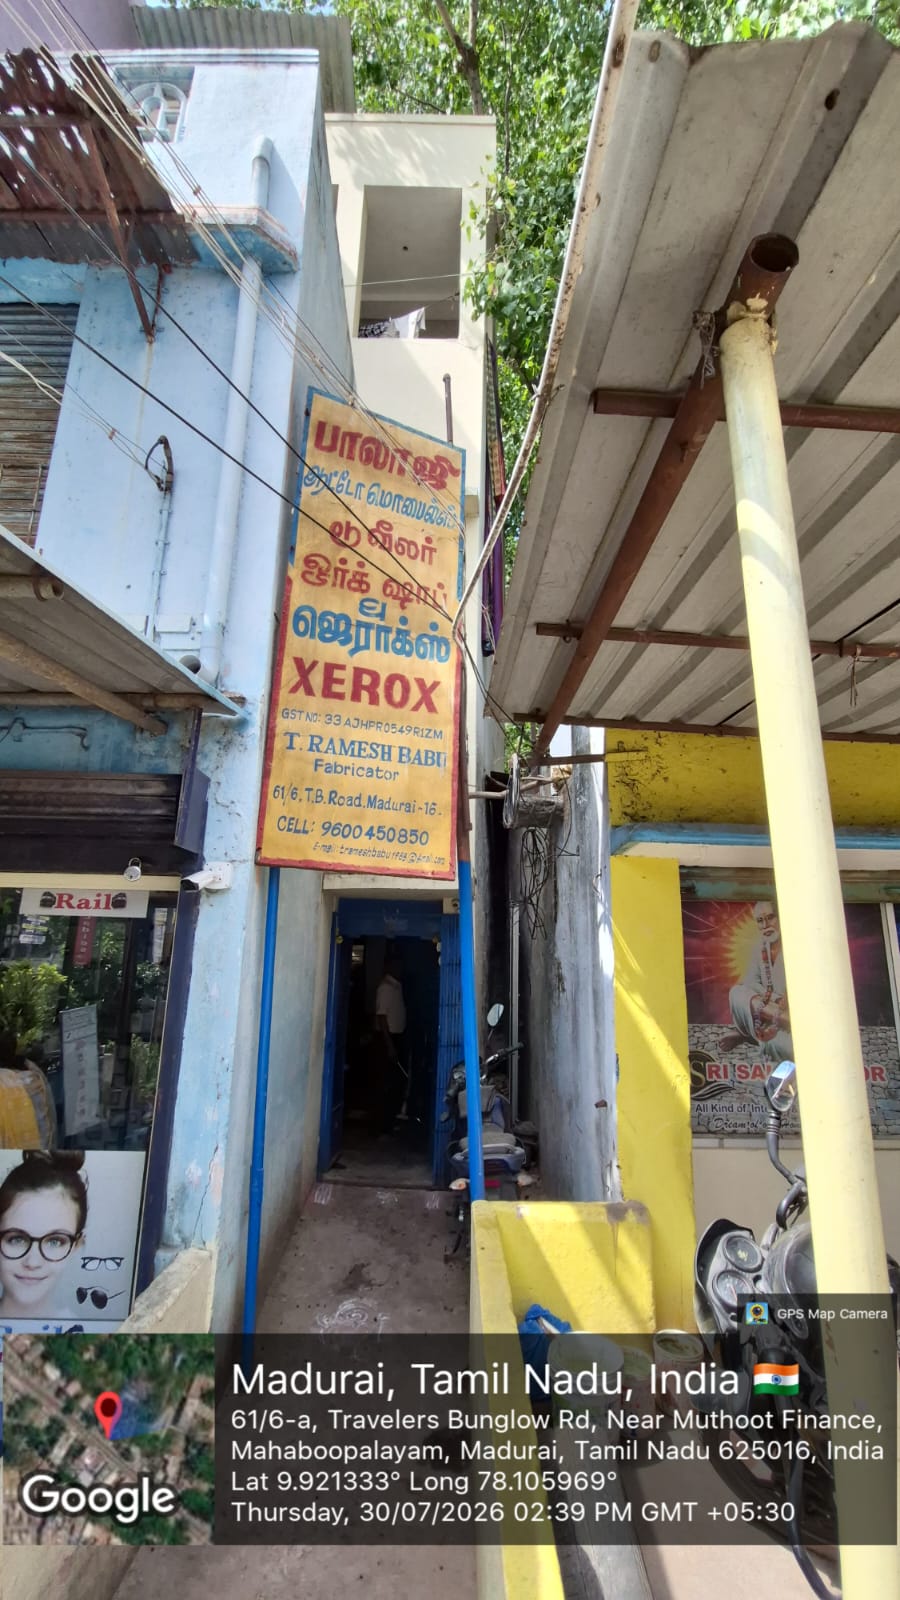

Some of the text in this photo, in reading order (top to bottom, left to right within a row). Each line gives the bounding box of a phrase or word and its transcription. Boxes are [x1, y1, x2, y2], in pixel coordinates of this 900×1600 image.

[313, 420, 461, 491] பாலாஜி
[367, 519, 437, 566] வீலர்
[292, 604, 450, 663] ஜெராக்ஸ்
[288, 656, 441, 714] XEROX
[281, 707, 304, 721] GST
[307, 734, 392, 762] RAMESH
[397, 745, 447, 769] BABU
[313, 758, 400, 781] Fabricator
[276, 815, 429, 846] CELL: 9600450850
[54, 892, 111, 910] Rail
[695, 1103, 708, 1113] All
[711, 1103, 734, 1113] Kind
[737, 1103, 747, 1113] of
